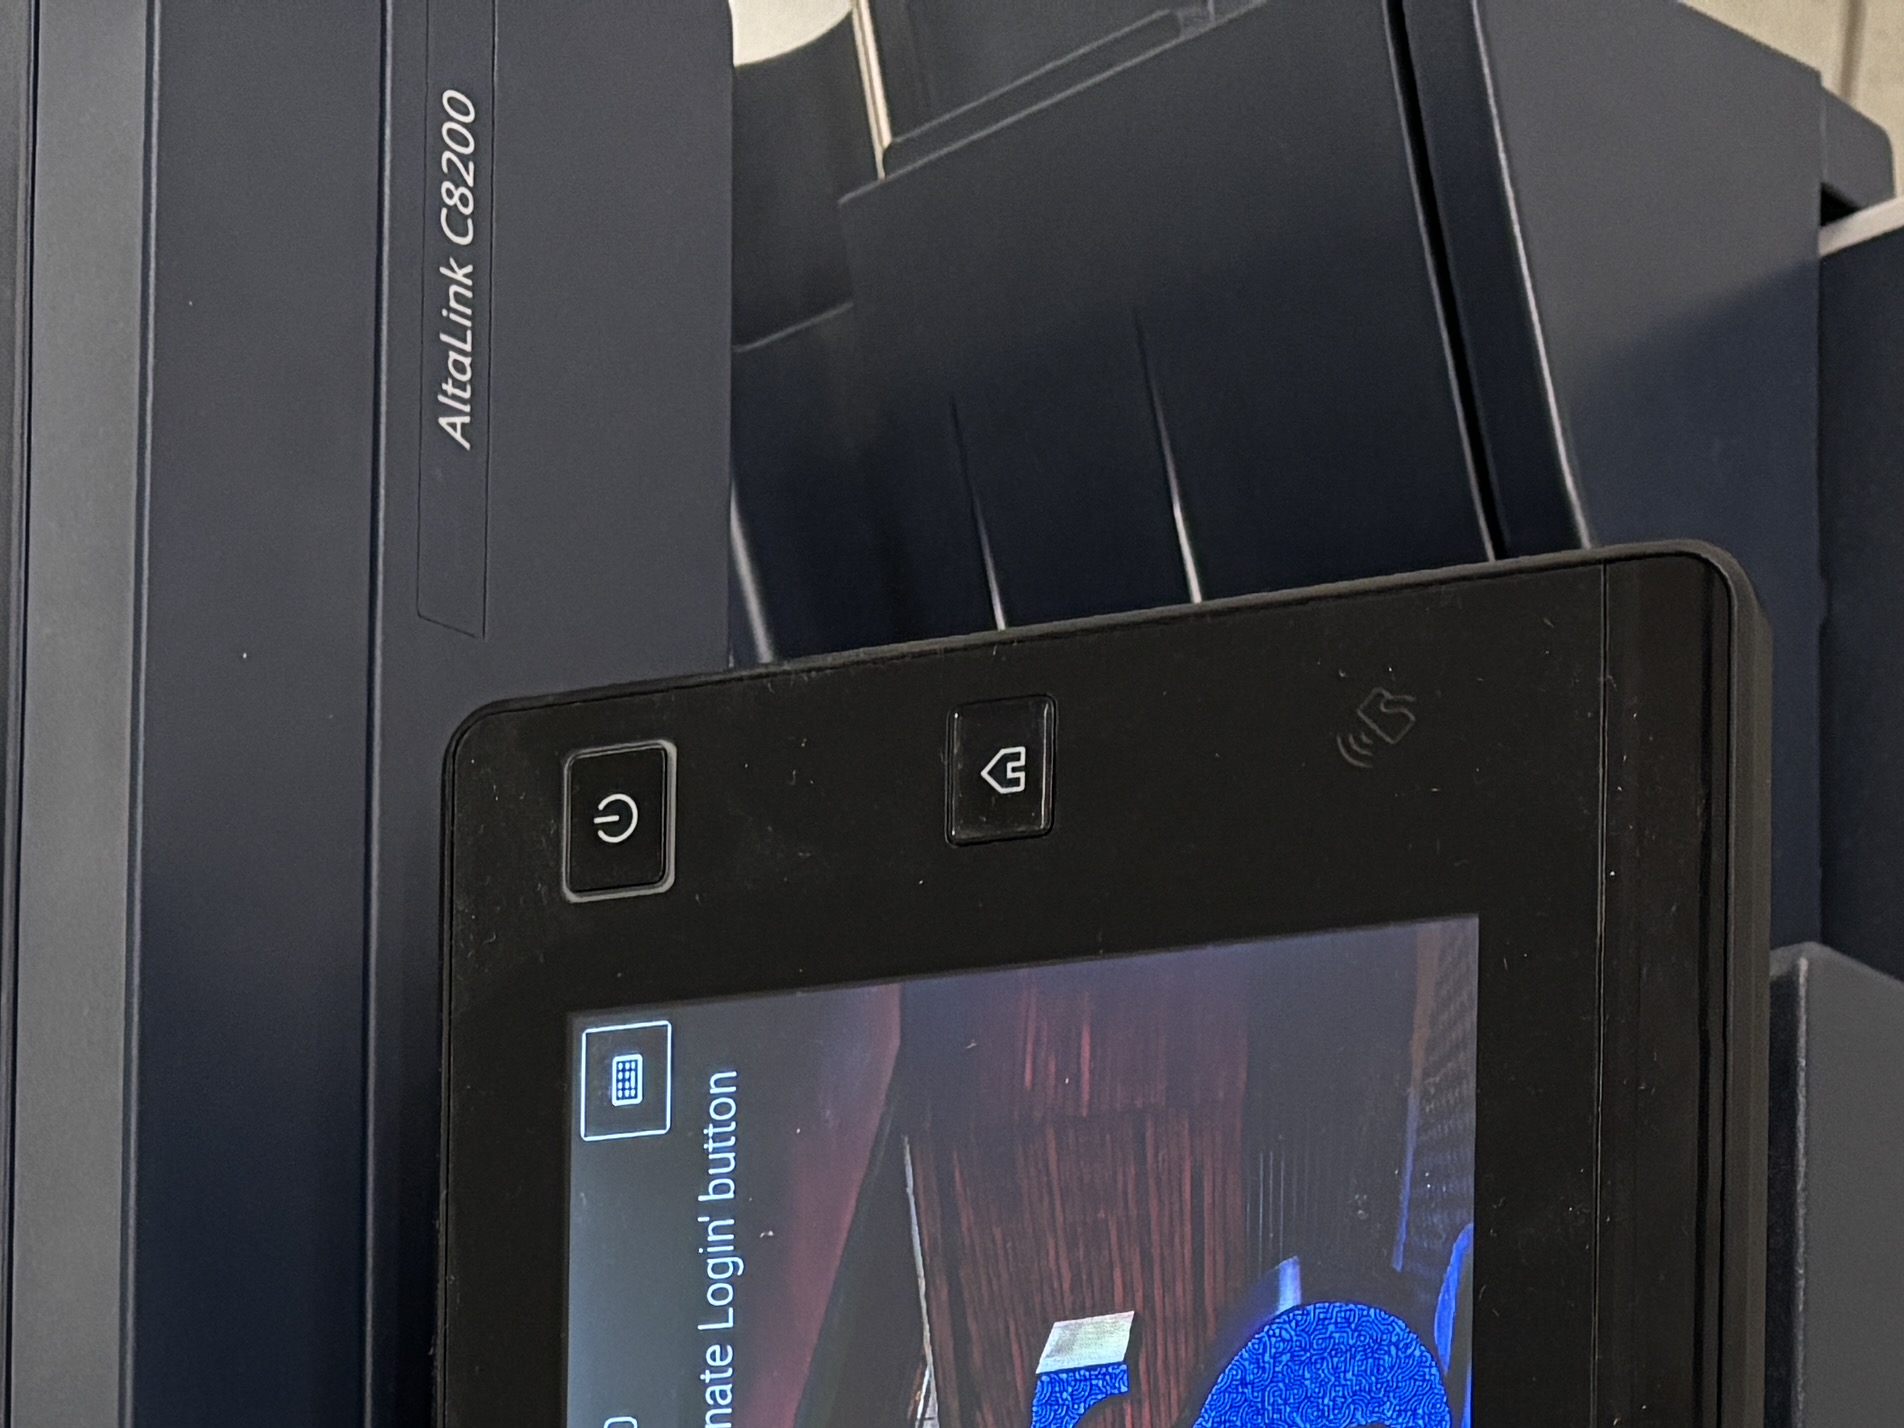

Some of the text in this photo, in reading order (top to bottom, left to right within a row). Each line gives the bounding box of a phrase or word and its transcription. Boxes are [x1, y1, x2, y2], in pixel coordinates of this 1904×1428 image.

[437, 90, 475, 450] AltaLink C8200
[701, 1070, 738, 1200] button
[699, 1214, 744, 1331] Login'
